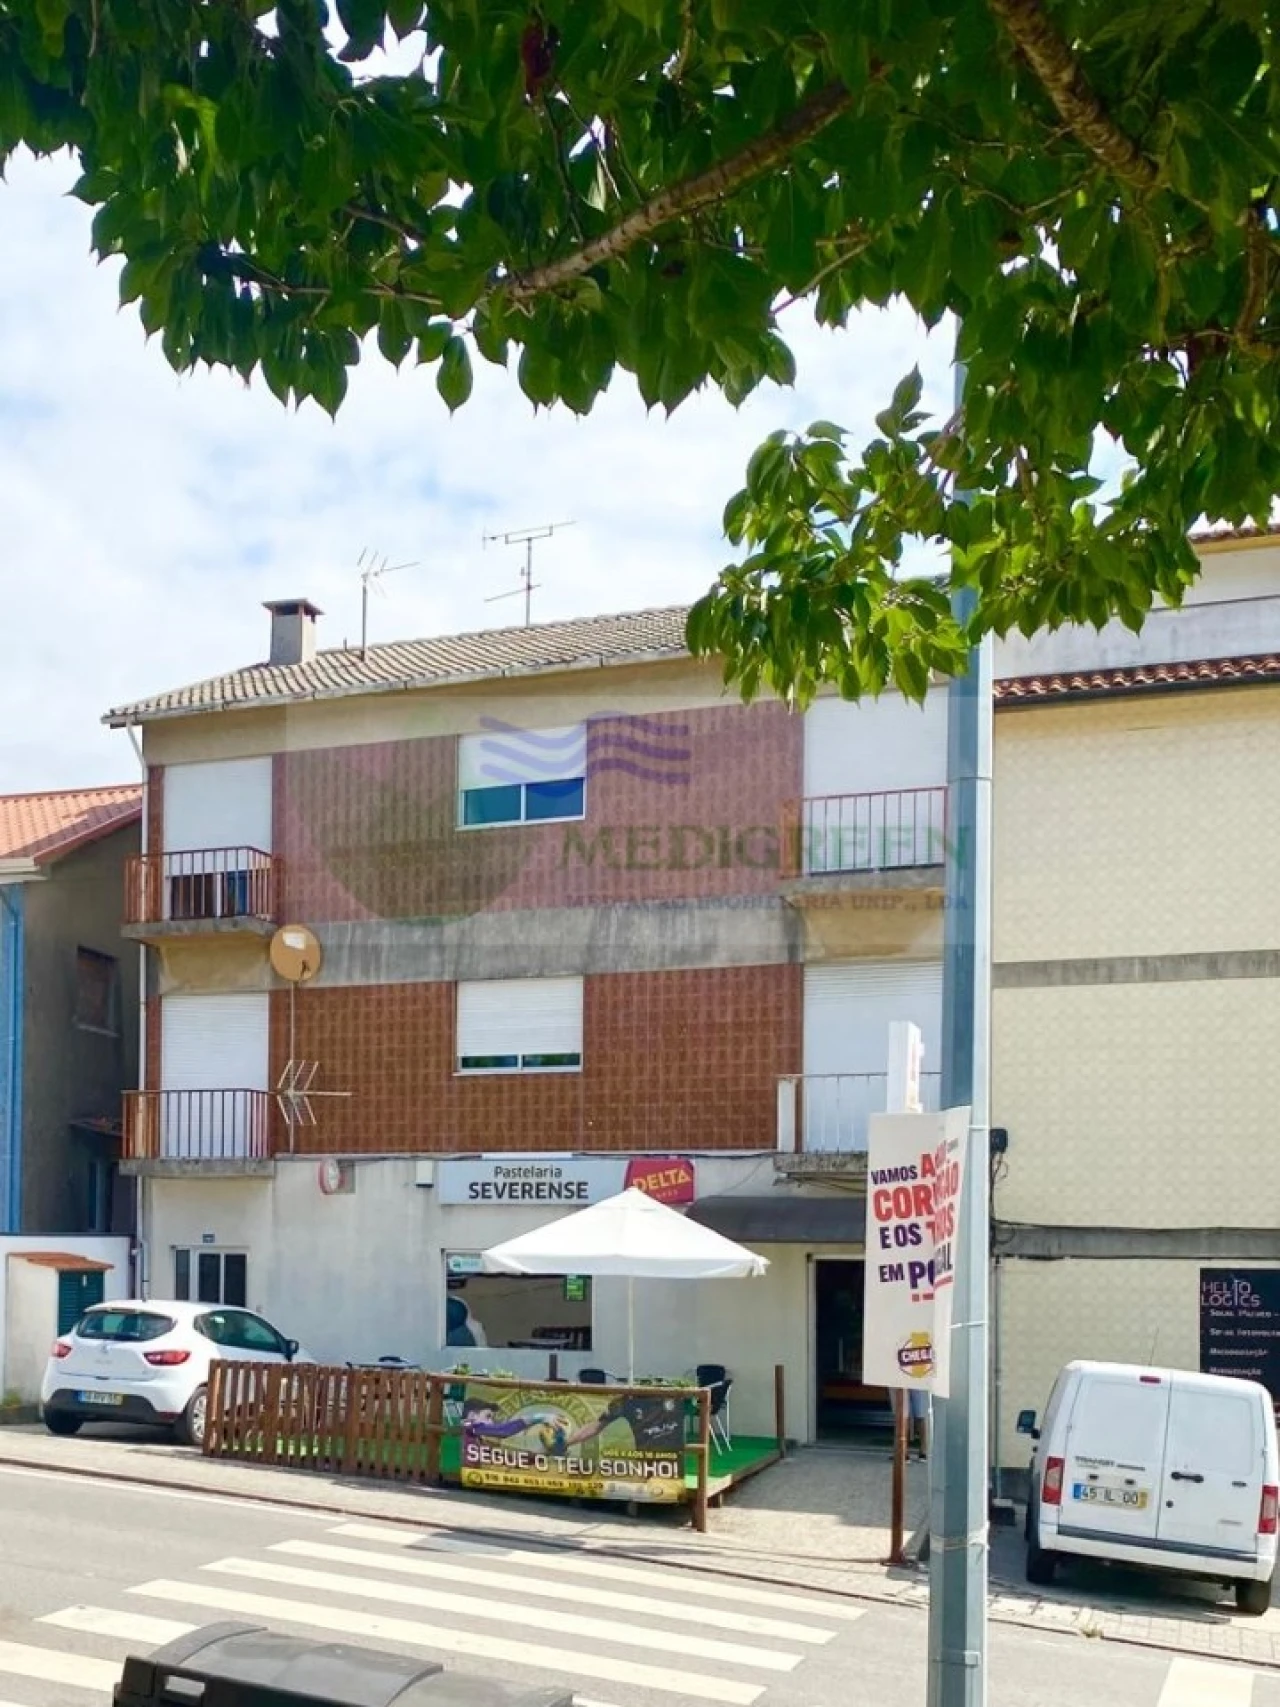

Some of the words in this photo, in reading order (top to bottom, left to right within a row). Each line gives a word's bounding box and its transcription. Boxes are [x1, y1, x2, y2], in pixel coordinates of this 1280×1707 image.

[494, 1165, 563, 1179] Pastelaria
[632, 1167, 691, 1191] DELTA
[871, 1165, 918, 1185] VAMOS
[468, 1181, 589, 1200] SEVERENSE
[879, 1226, 891, 1249] E
[894, 1223, 922, 1247] OS
[879, 1263, 904, 1283] EM
[466, 1443, 529, 1469] SEGUE
[534, 1454, 549, 1472] O
[554, 1455, 593, 1475] TEU
[600, 1459, 679, 1479] SONHO!
